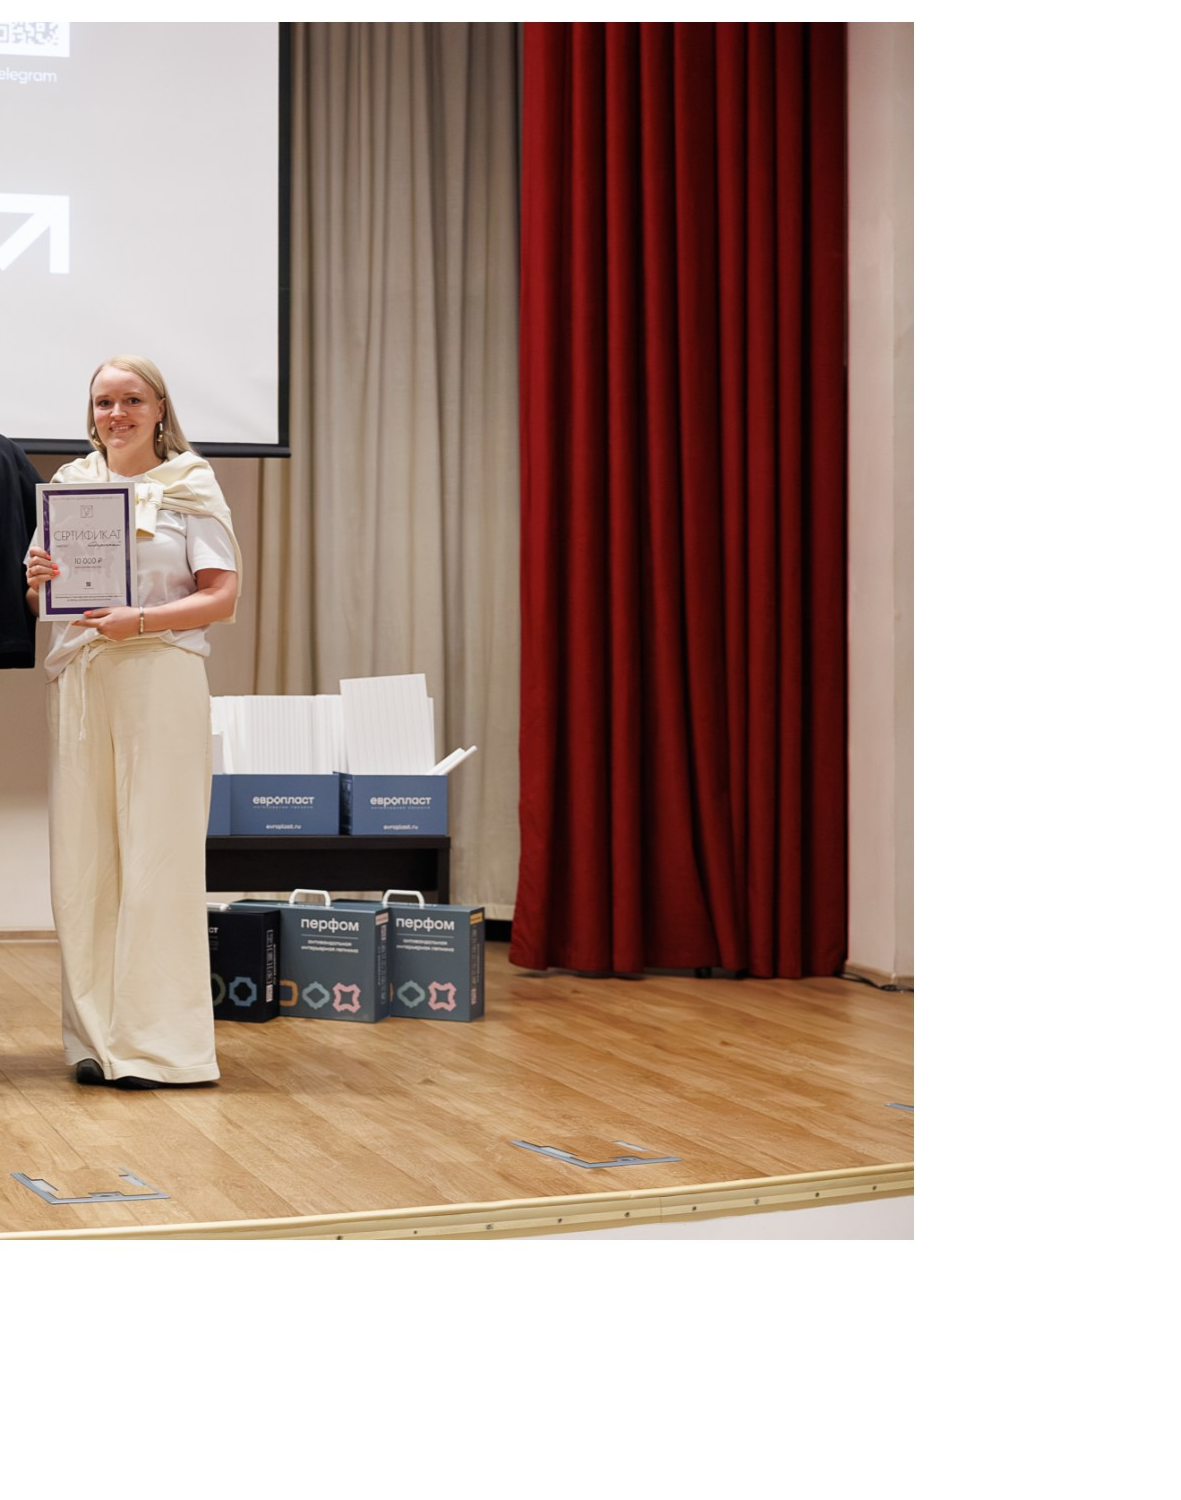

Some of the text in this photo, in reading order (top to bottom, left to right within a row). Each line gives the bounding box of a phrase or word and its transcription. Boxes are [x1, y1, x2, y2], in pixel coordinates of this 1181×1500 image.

[53, 529, 122, 541] СЕРТИФИКАТ
[252, 796, 315, 806] европласт
[370, 796, 431, 807] европласт
[300, 917, 359, 933] перфом
[395, 916, 455, 932] перфом
